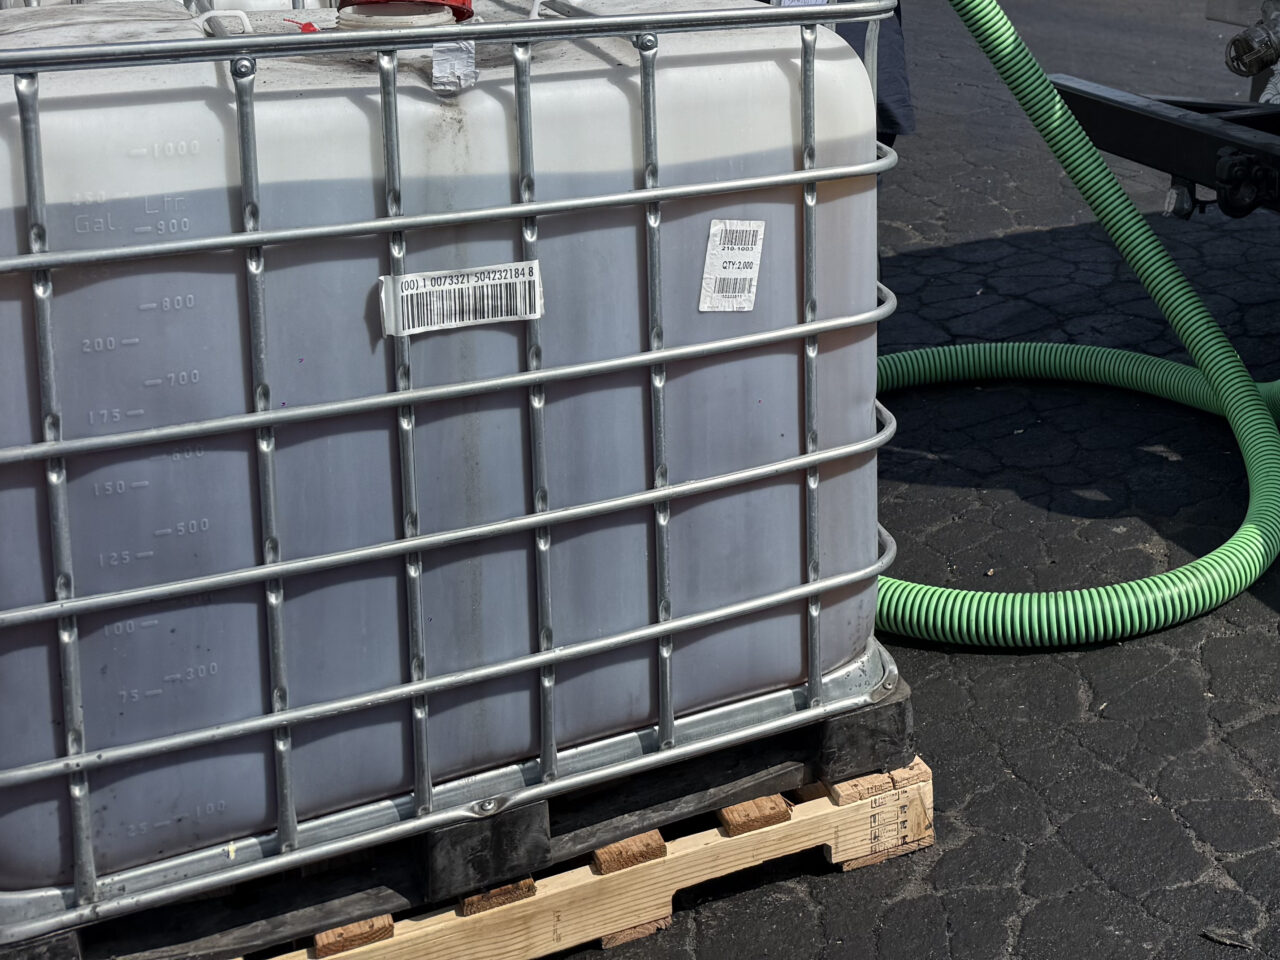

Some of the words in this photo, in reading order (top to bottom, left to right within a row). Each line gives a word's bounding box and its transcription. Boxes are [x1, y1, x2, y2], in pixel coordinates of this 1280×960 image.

[152, 140, 201, 158] 1000
[155, 217, 191, 235] 900
[400, 279, 419, 293] (00)
[422, 277, 427, 289] 1
[430, 273, 470, 288] 0073321
[474, 268, 525, 283] 504232184
[528, 266, 534, 278] 8
[161, 294, 195, 312] 800
[82, 336, 116, 353] 200
[167, 369, 200, 386] 700
[88, 408, 121, 425] 175
[94, 480, 126, 497] 150
[176, 518, 209, 536] 500
[99, 551, 130, 567] 125
[104, 620, 136, 637] 100
[185, 662, 218, 679] 300
[195, 799, 226, 818] 100
